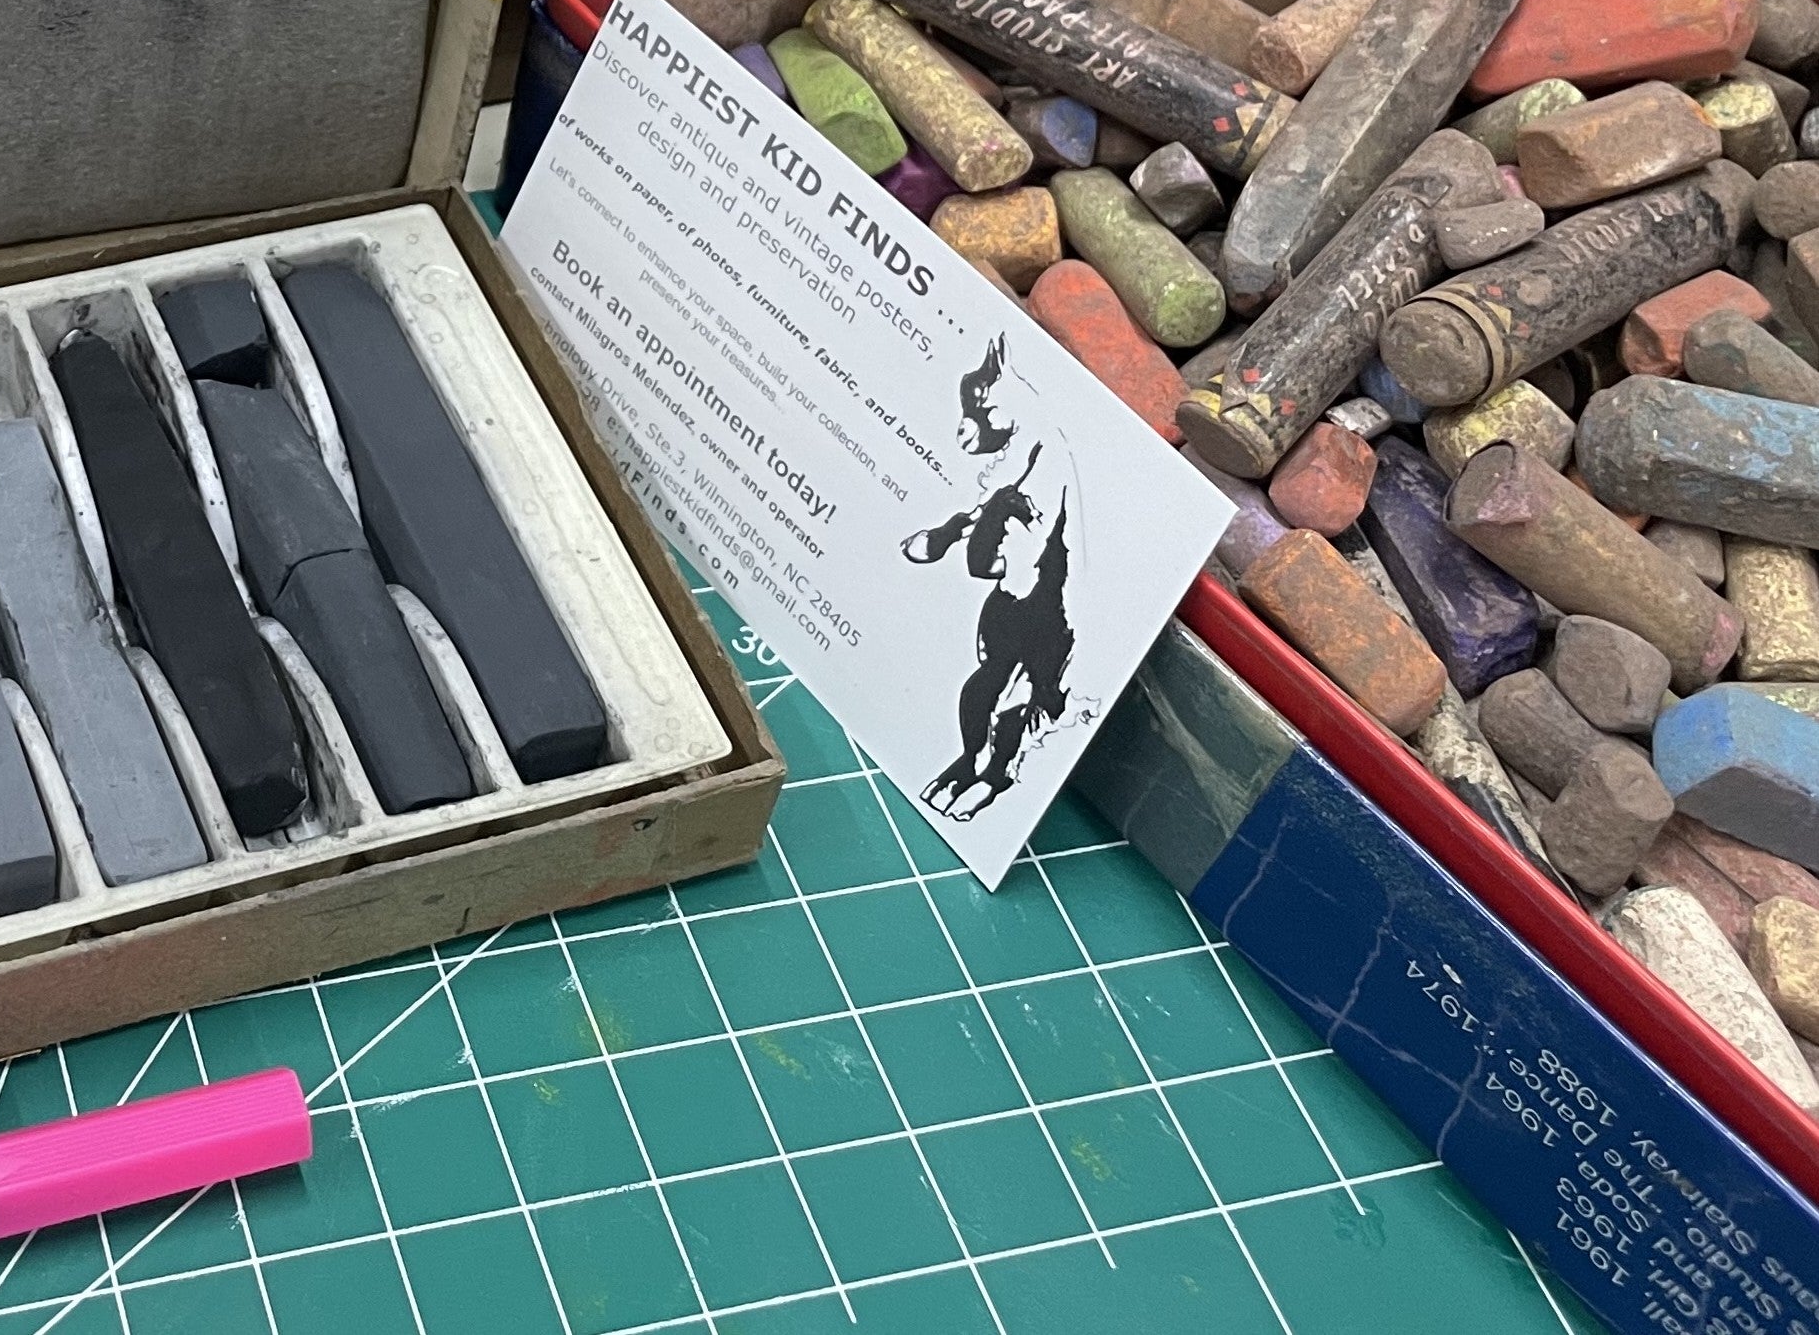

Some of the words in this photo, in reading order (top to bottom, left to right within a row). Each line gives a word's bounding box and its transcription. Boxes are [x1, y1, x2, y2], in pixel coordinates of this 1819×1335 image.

[1068, 41, 1139, 95] ART
[591, 38, 669, 119] Discover
[667, 105, 742, 184] antique
[741, 169, 781, 216] and
[779, 206, 856, 287] vintage
[854, 277, 939, 364] posters,
[634, 114, 698, 184] design
[698, 169, 738, 215] and
[736, 205, 859, 330] preservation
[760, 131, 825, 202] KID
[827, 190, 936, 301] FINDS
[549, 156, 578, 190] Let's
[576, 182, 622, 232] connect
[622, 225, 637, 245] to
[636, 237, 687, 293] enhance
[685, 287, 715, 322] your
[756, 351, 788, 387] build
[785, 382, 817, 418] your
[880, 471, 909, 503] and
[558, 108, 576, 131] of
[574, 122, 615, 168] works
[613, 162, 632, 184] on
[631, 179, 675, 227] paper,
[676, 217, 696, 241] of
[691, 232, 745, 290] photos,
[745, 280, 814, 353] furniture,
[813, 345, 863, 399] fabric,
[864, 393, 896, 428] and
[894, 422, 955, 485] books...
[638, 266, 692, 326] preserve
[690, 316, 720, 352] your
[529, 263, 575, 314] contact
[573, 305, 632, 371] Milagros
[631, 360, 701, 437] Melendez,
[698, 430, 740, 477] owner
[740, 470, 768, 503] and
[765, 497, 826, 565] operator
[551, 237, 606, 301] Book
[605, 294, 633, 328] an
[632, 316, 767, 461] appointment
[762, 444, 838, 530] today!
[598, 375, 644, 429] Drive,
[643, 420, 690, 475] Ste.3,
[689, 467, 783, 569] Wilmington,
[782, 562, 809, 595] NC
[808, 589, 860, 646] 28405
[623, 429, 834, 654] happiestkidfinds@gmail.com
[1399, 956, 1481, 1035] 1974
[1480, 1069, 1563, 1149] 1964
[1532, 1045, 1621, 1130] 1988
[1551, 1174, 1636, 1257] 1963
[1565, 1149, 1655, 1235] Soda,
[1622, 1126, 1761, 1260] Stairway,
[1546, 1205, 1632, 1289] 1961
[1637, 1257, 1704, 1322] Girl,
[1652, 1234, 1715, 1295] and
[1673, 1214, 1786, 1323] Studio,
